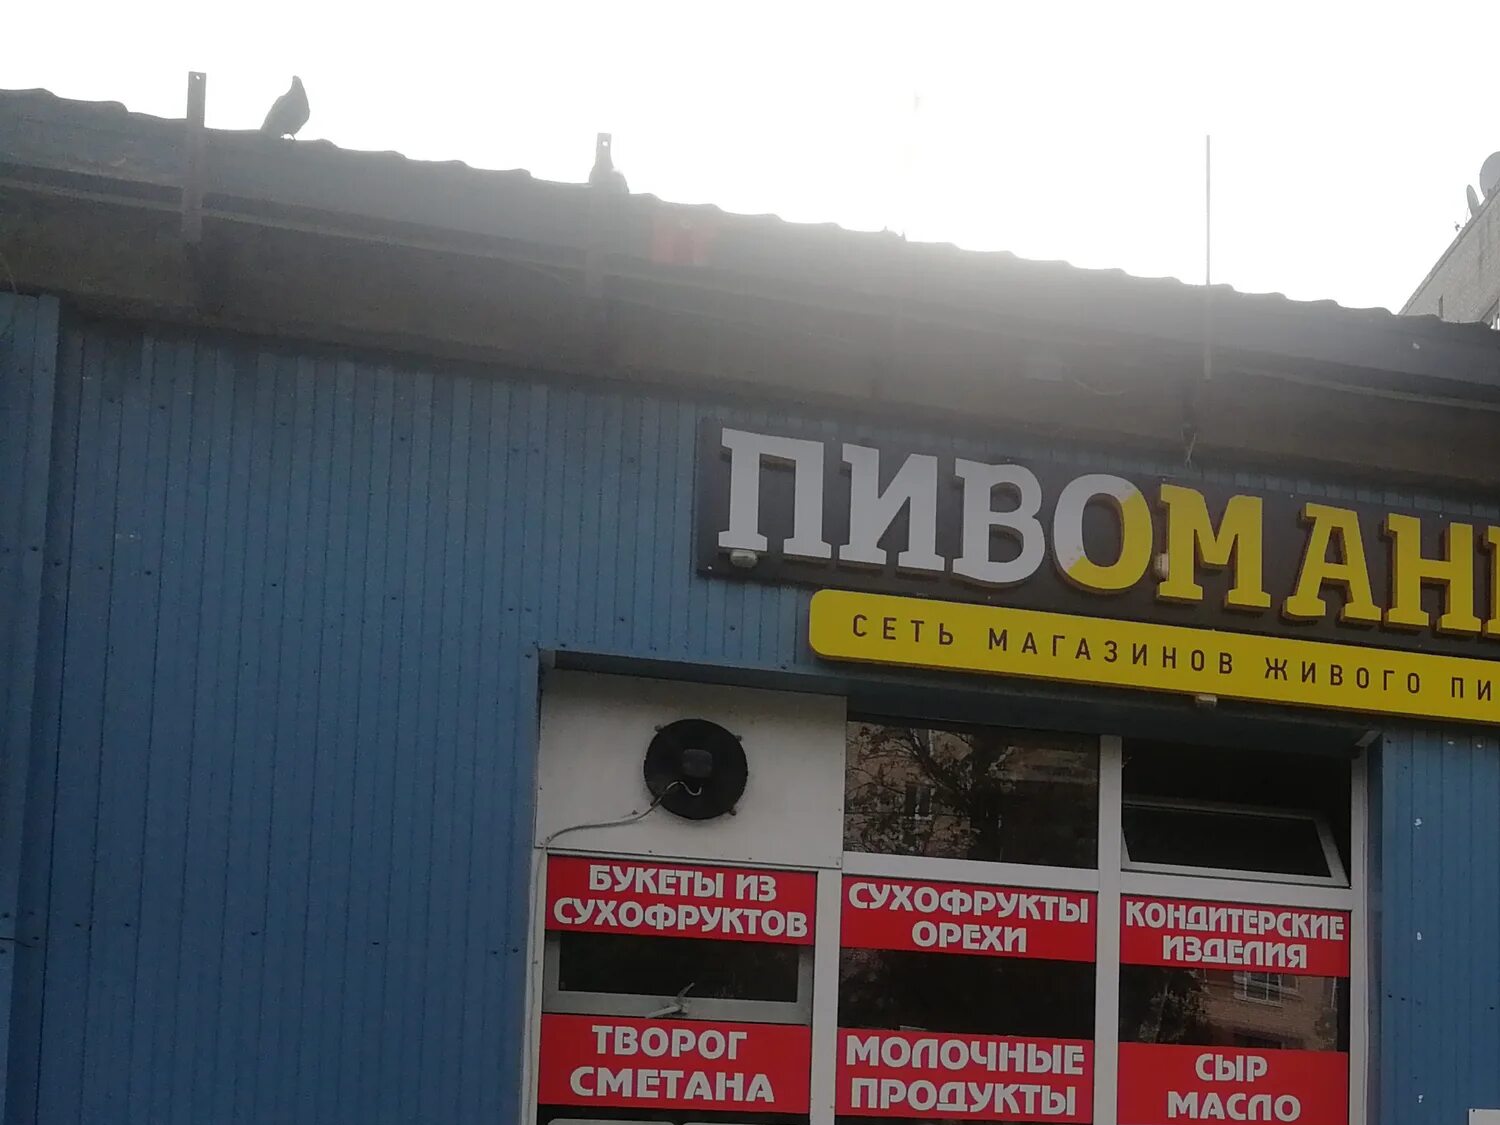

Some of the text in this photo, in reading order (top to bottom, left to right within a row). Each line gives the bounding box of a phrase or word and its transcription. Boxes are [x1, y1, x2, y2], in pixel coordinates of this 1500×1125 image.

[853, 614, 954, 646] СЕТЬ
[988, 627, 1233, 674] МАГАЗИНОВ
[1264, 657, 1420, 695] ЖИВОГО
[589, 864, 777, 902] БУКЕТЫ ИЗ
[553, 897, 808, 938] СУХОФРУКТОВ
[848, 882, 1089, 924] СУХОФРУКТЫ
[1125, 900, 1345, 941] КОНДИТЕРСКИЕ
[911, 920, 1027, 953] ОРЕХИ
[1162, 936, 1307, 969] ИЗДЕЛИЯ
[591, 1024, 748, 1060] ТВОРОГ
[846, 1035, 1085, 1075] МОЛОЧНЫЕ
[570, 1066, 775, 1103] СМЕТАНА
[1195, 1053, 1268, 1083] СЫР
[851, 1077, 1076, 1116] ПРОДУКТЫ
[1167, 1090, 1301, 1122] МАСЛО
